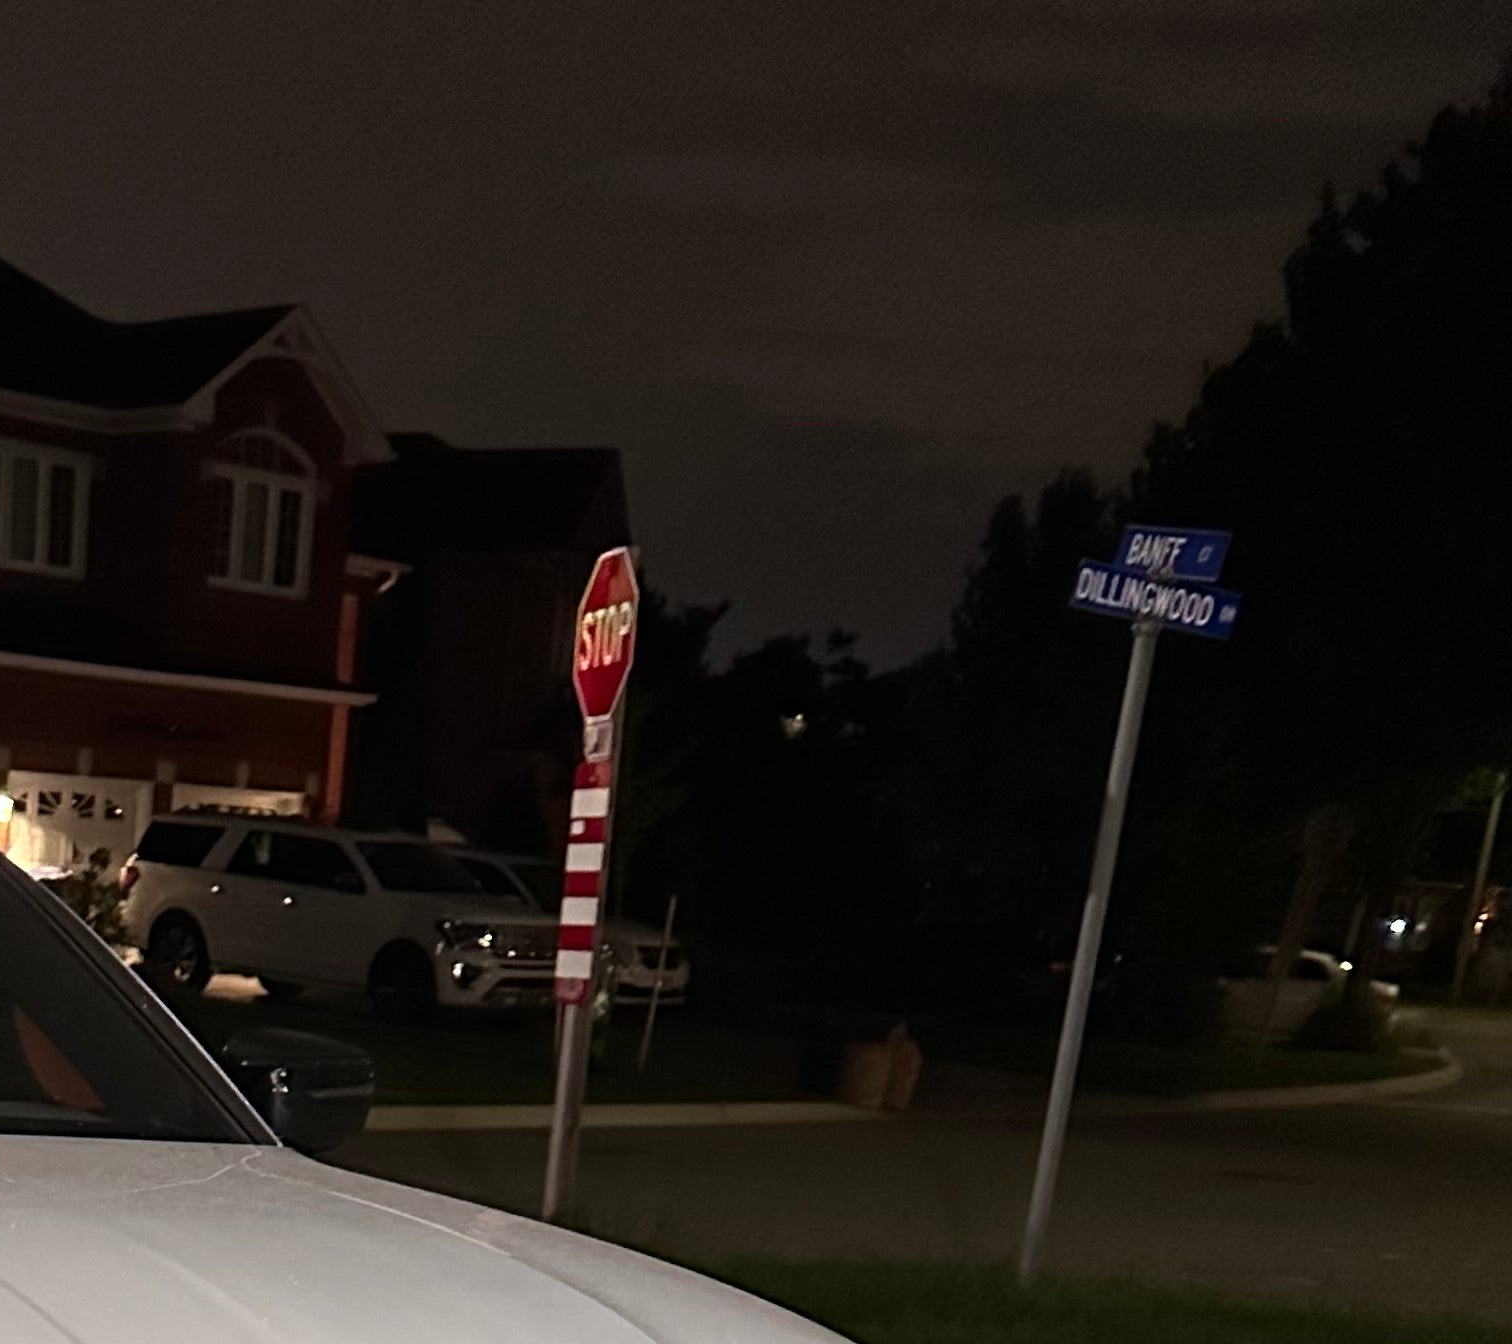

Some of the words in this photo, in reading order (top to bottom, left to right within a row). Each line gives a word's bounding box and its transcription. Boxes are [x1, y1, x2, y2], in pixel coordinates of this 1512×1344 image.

[1125, 533, 1188, 566] BANFF
[1076, 567, 1216, 627] DILLINGWOOD
[578, 601, 632, 671] STOP
